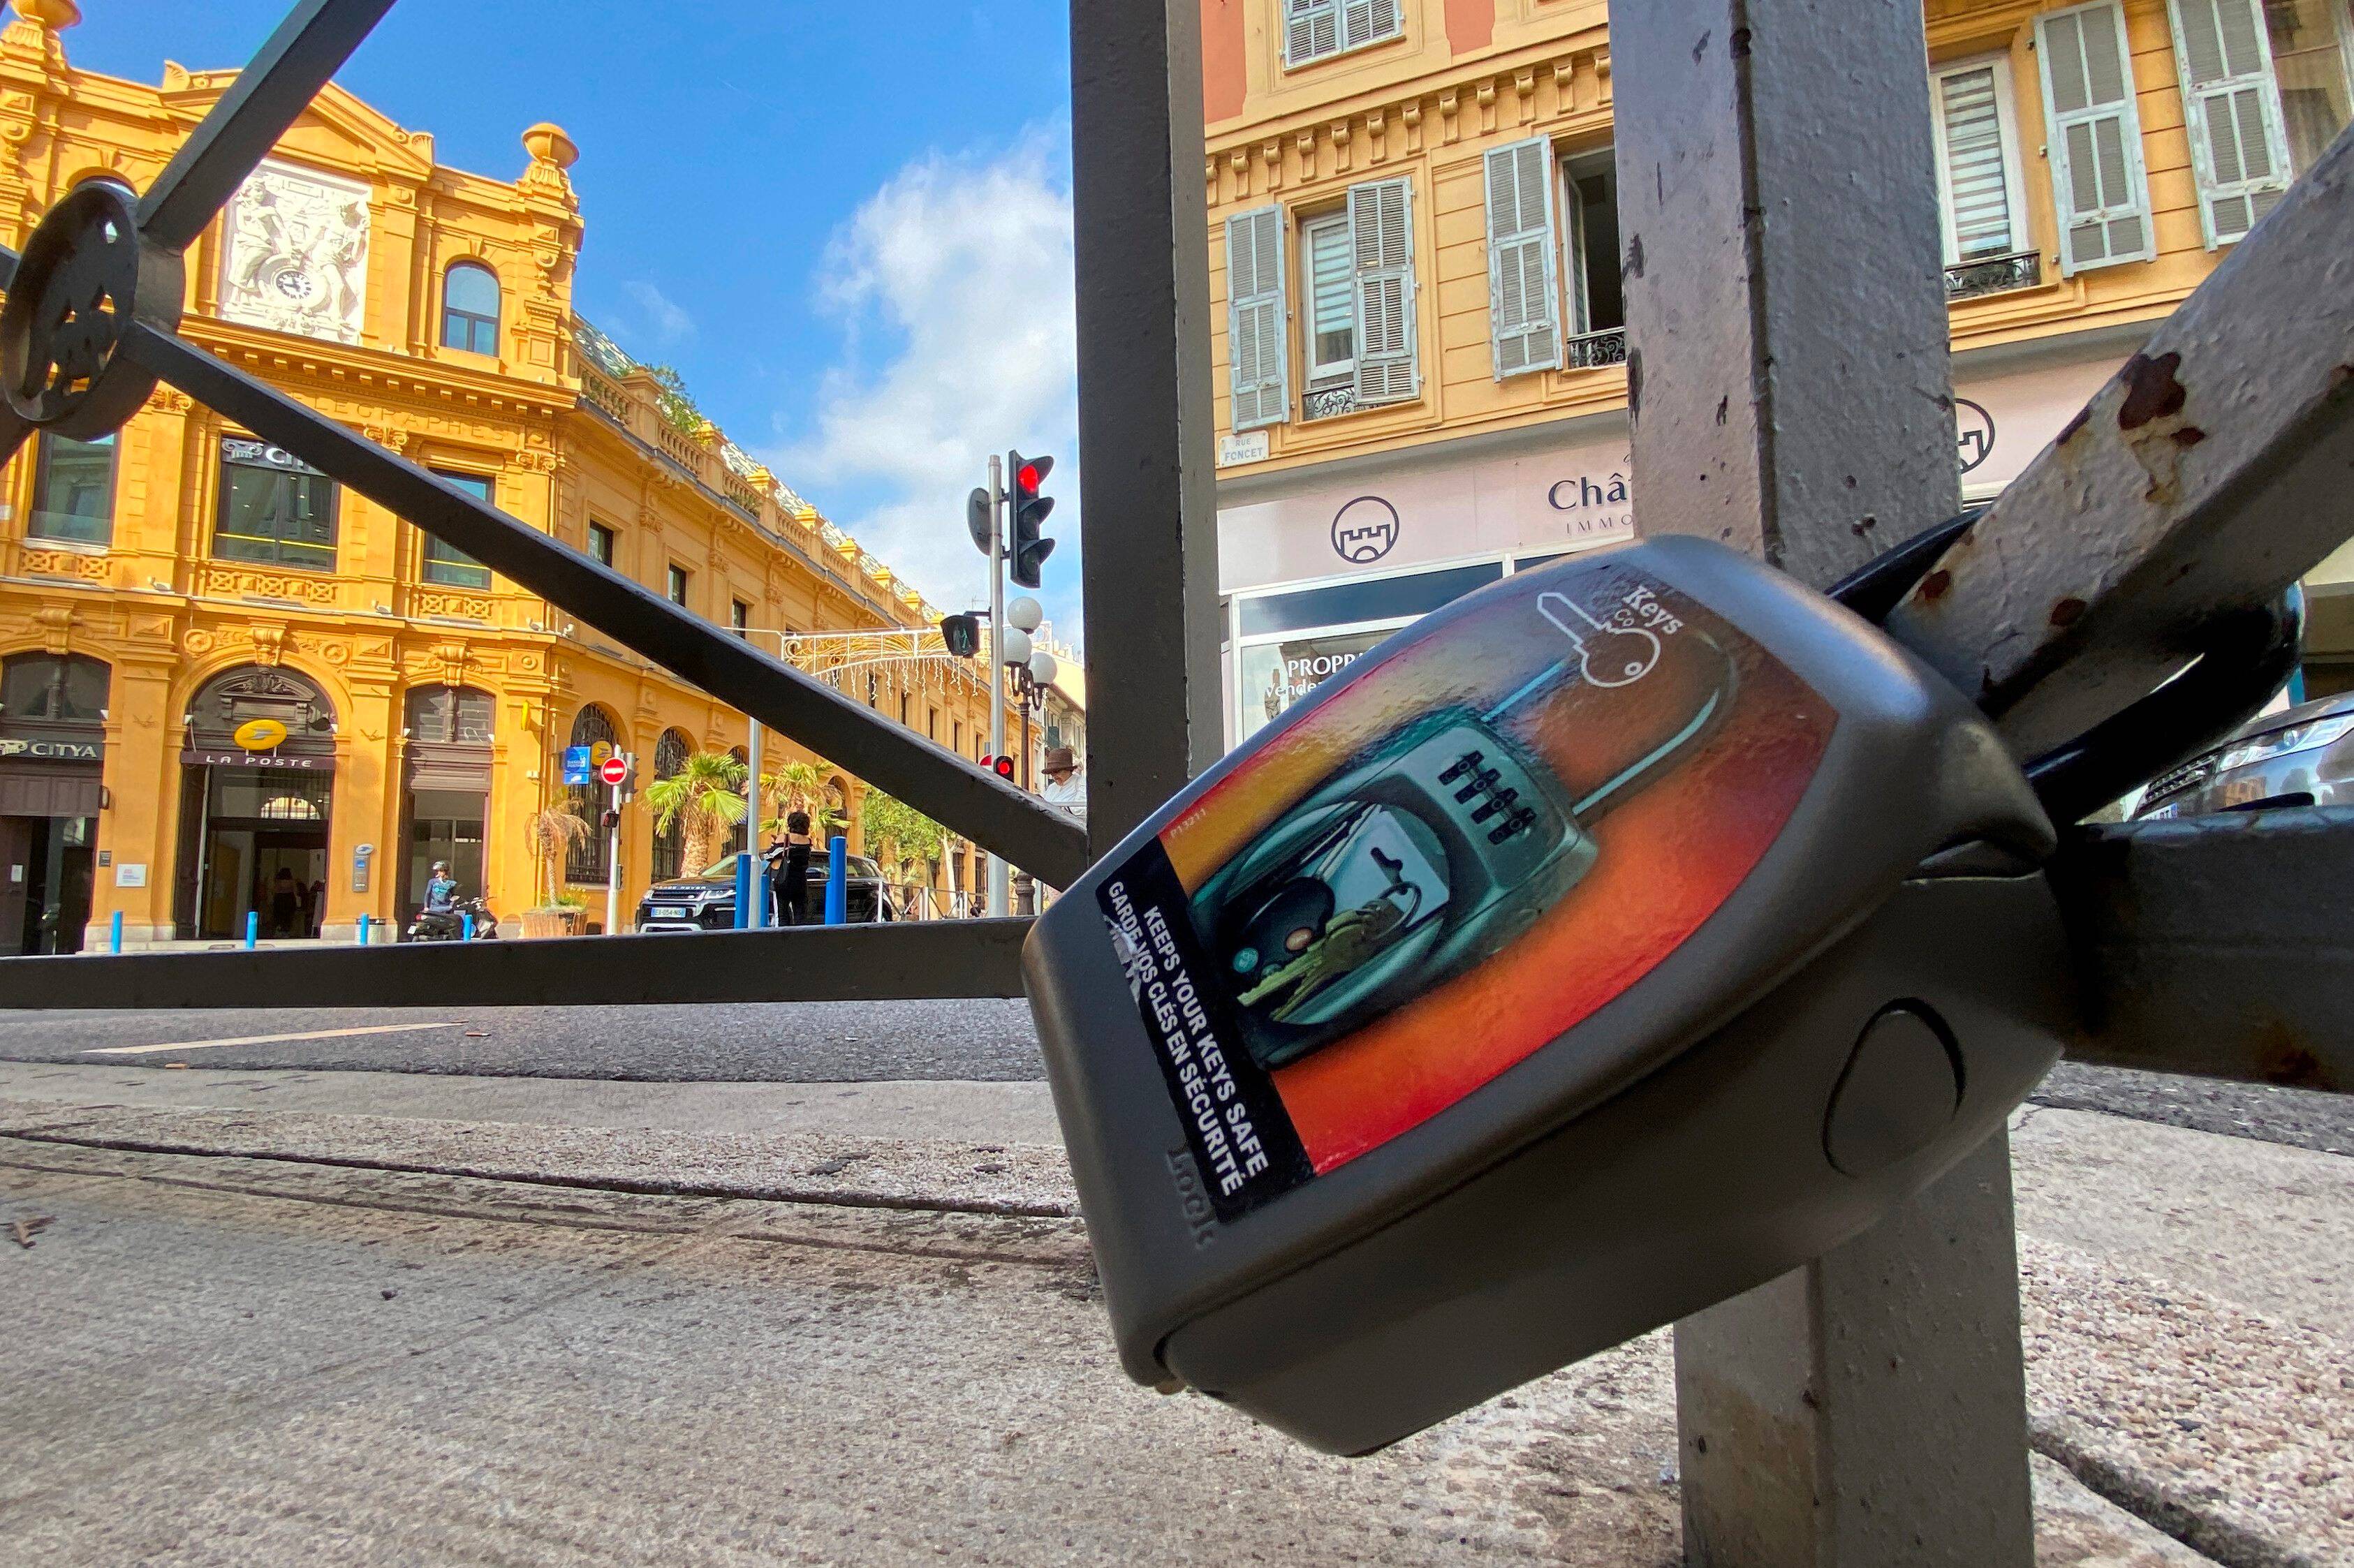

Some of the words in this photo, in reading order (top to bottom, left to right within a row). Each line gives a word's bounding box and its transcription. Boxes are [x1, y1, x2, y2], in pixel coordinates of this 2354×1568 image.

[1235, 438, 1251, 447] RUE
[1548, 473, 1631, 510] Châ
[1614, 609, 1635, 627] Co
[1621, 585, 1684, 634] Keys
[31, 743, 97, 757] CITYA
[206, 755, 232, 764] LA
[245, 757, 313, 768] POSTE
[1109, 881, 1143, 942] GARDE
[1148, 981, 1179, 1033] CLÉS
[1166, 1029, 1191, 1065] EN
[1179, 1063, 1246, 1197] SÉCURITÉ
[1144, 905, 1180, 971] KEEPS
[1172, 968, 1207, 1036] YOUR
[1196, 1032, 1236, 1102] KEYS
[1226, 1103, 1269, 1178] SAFE
